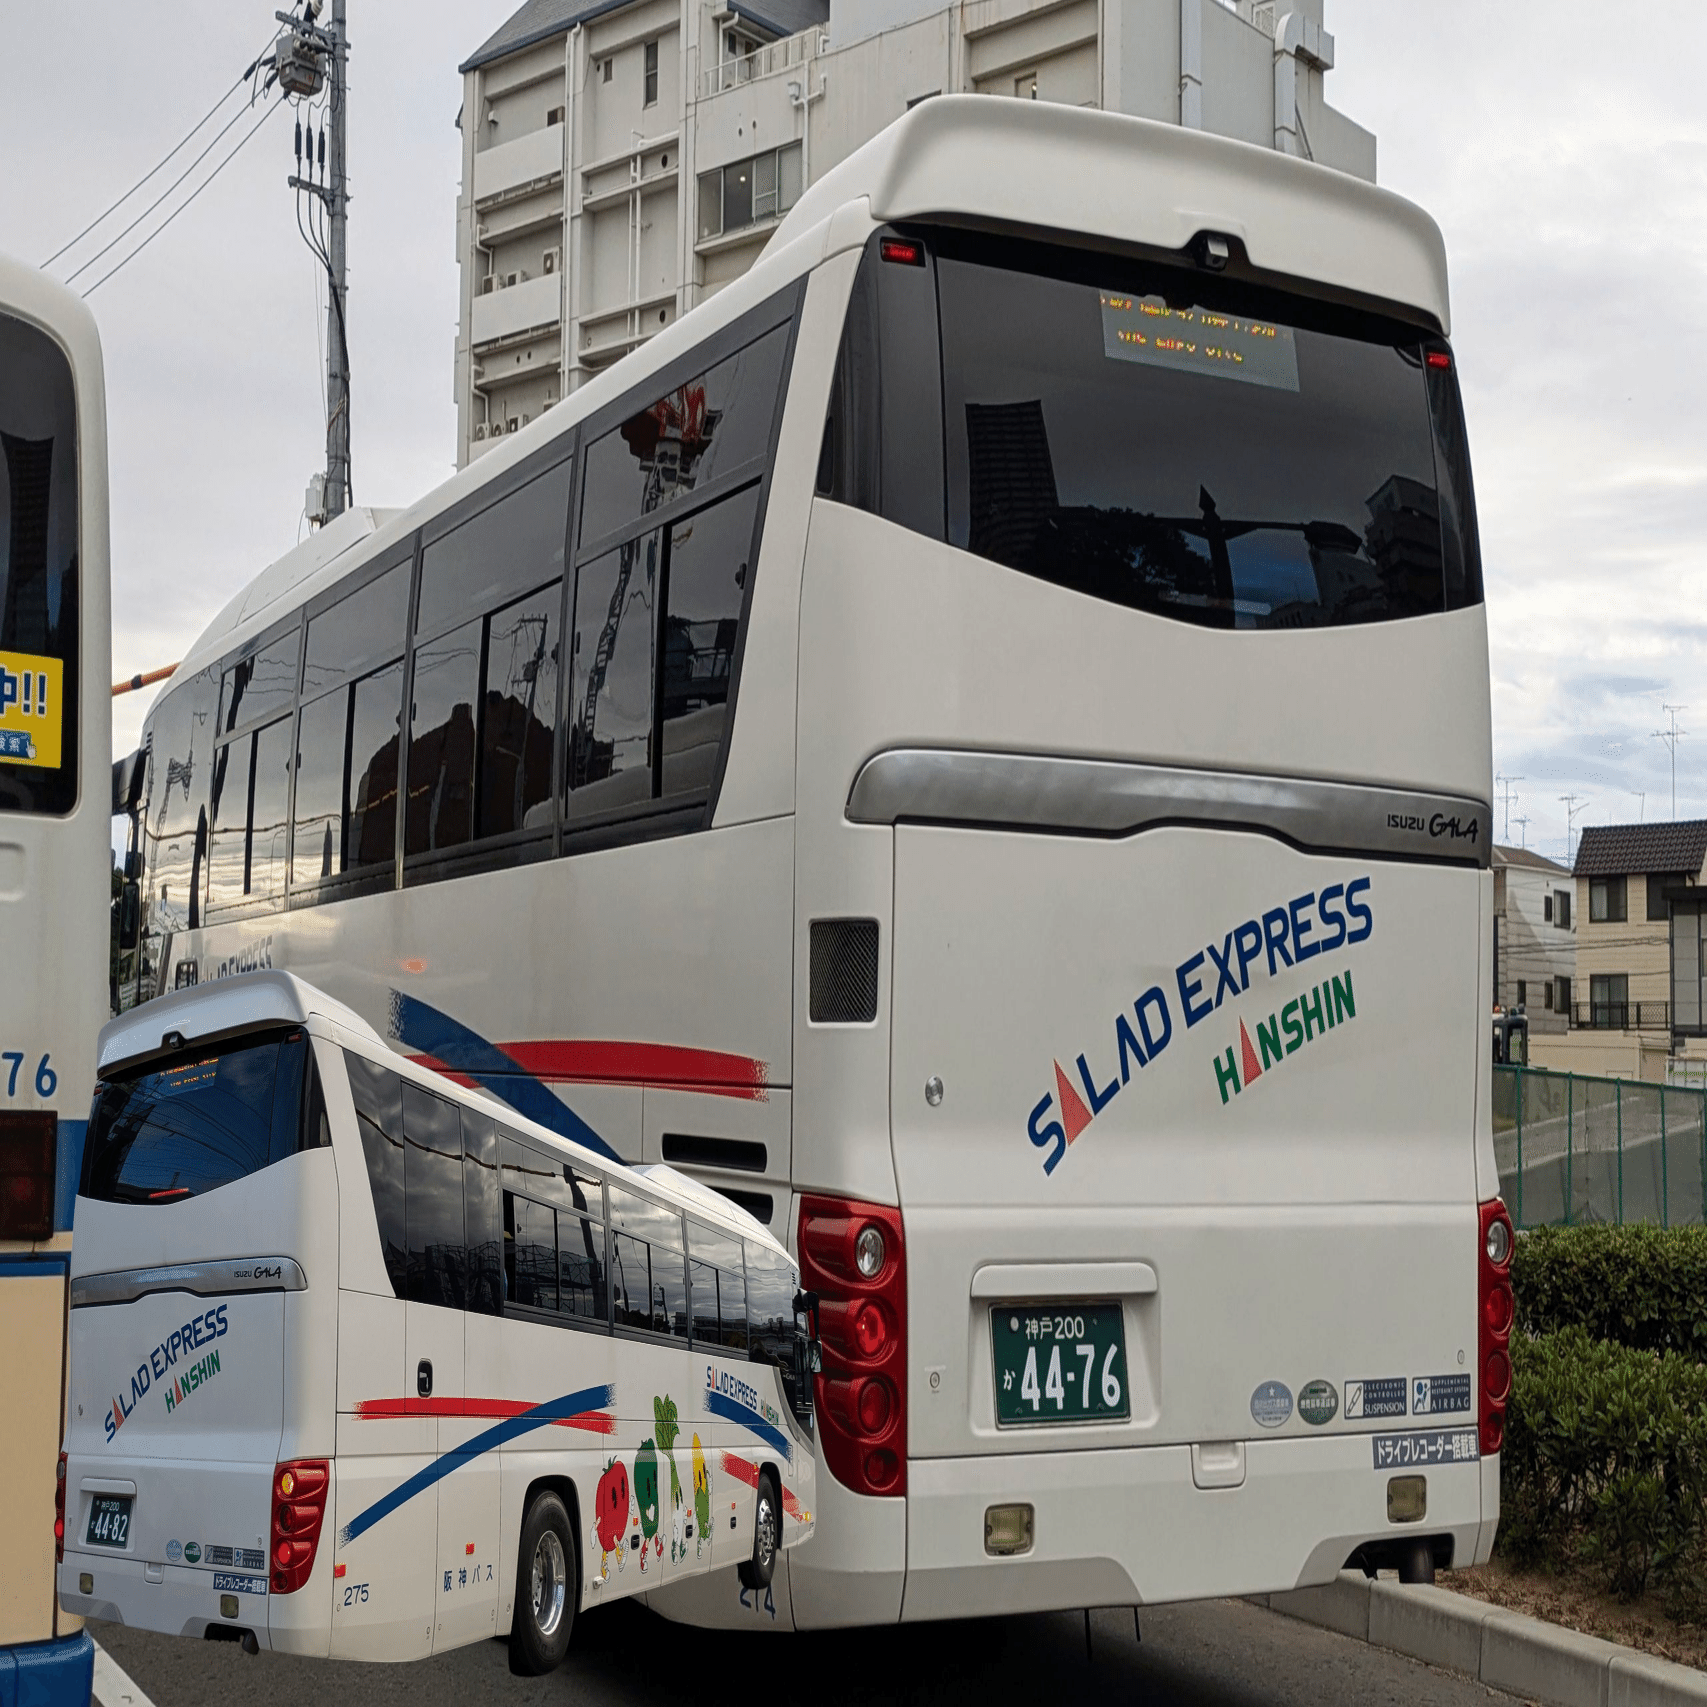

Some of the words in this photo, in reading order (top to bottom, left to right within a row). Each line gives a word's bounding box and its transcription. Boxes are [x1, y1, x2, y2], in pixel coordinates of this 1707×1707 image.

[1387, 814, 1425, 831] ISUZU
[1428, 813, 1479, 844] GALA
[1027, 985, 1172, 1177] SALAD
[1175, 876, 1373, 1029] EXPRESS
[1212, 969, 1356, 1106] HANSHIN
[1, 1052, 58, 1098] 76
[233, 1270, 252, 1278] ISUZU
[254, 1266, 282, 1279] GALA
[1025, 1316, 1085, 1340] 神戸200
[104, 1363, 151, 1444] SALAD
[150, 1303, 228, 1381] EXPRESS
[164, 1349, 221, 1414] HANSHIN
[706, 1362, 729, 1394] SALAD
[729, 1375, 758, 1411] EXPRESS
[1003, 1369, 1016, 1391] か
[1021, 1343, 1121, 1411] 44-76
[1364, 1381, 1405, 1391] ELECTRONIC
[1364, 1390, 1405, 1399] CONTROLLED
[1364, 1401, 1405, 1415] SUSPENSION
[1431, 1396, 1469, 1410] AIRBAG
[94, 1512, 128, 1541] 44-82
[443, 1564, 494, 1593] 阪神バス
[344, 1583, 370, 1607] 275
